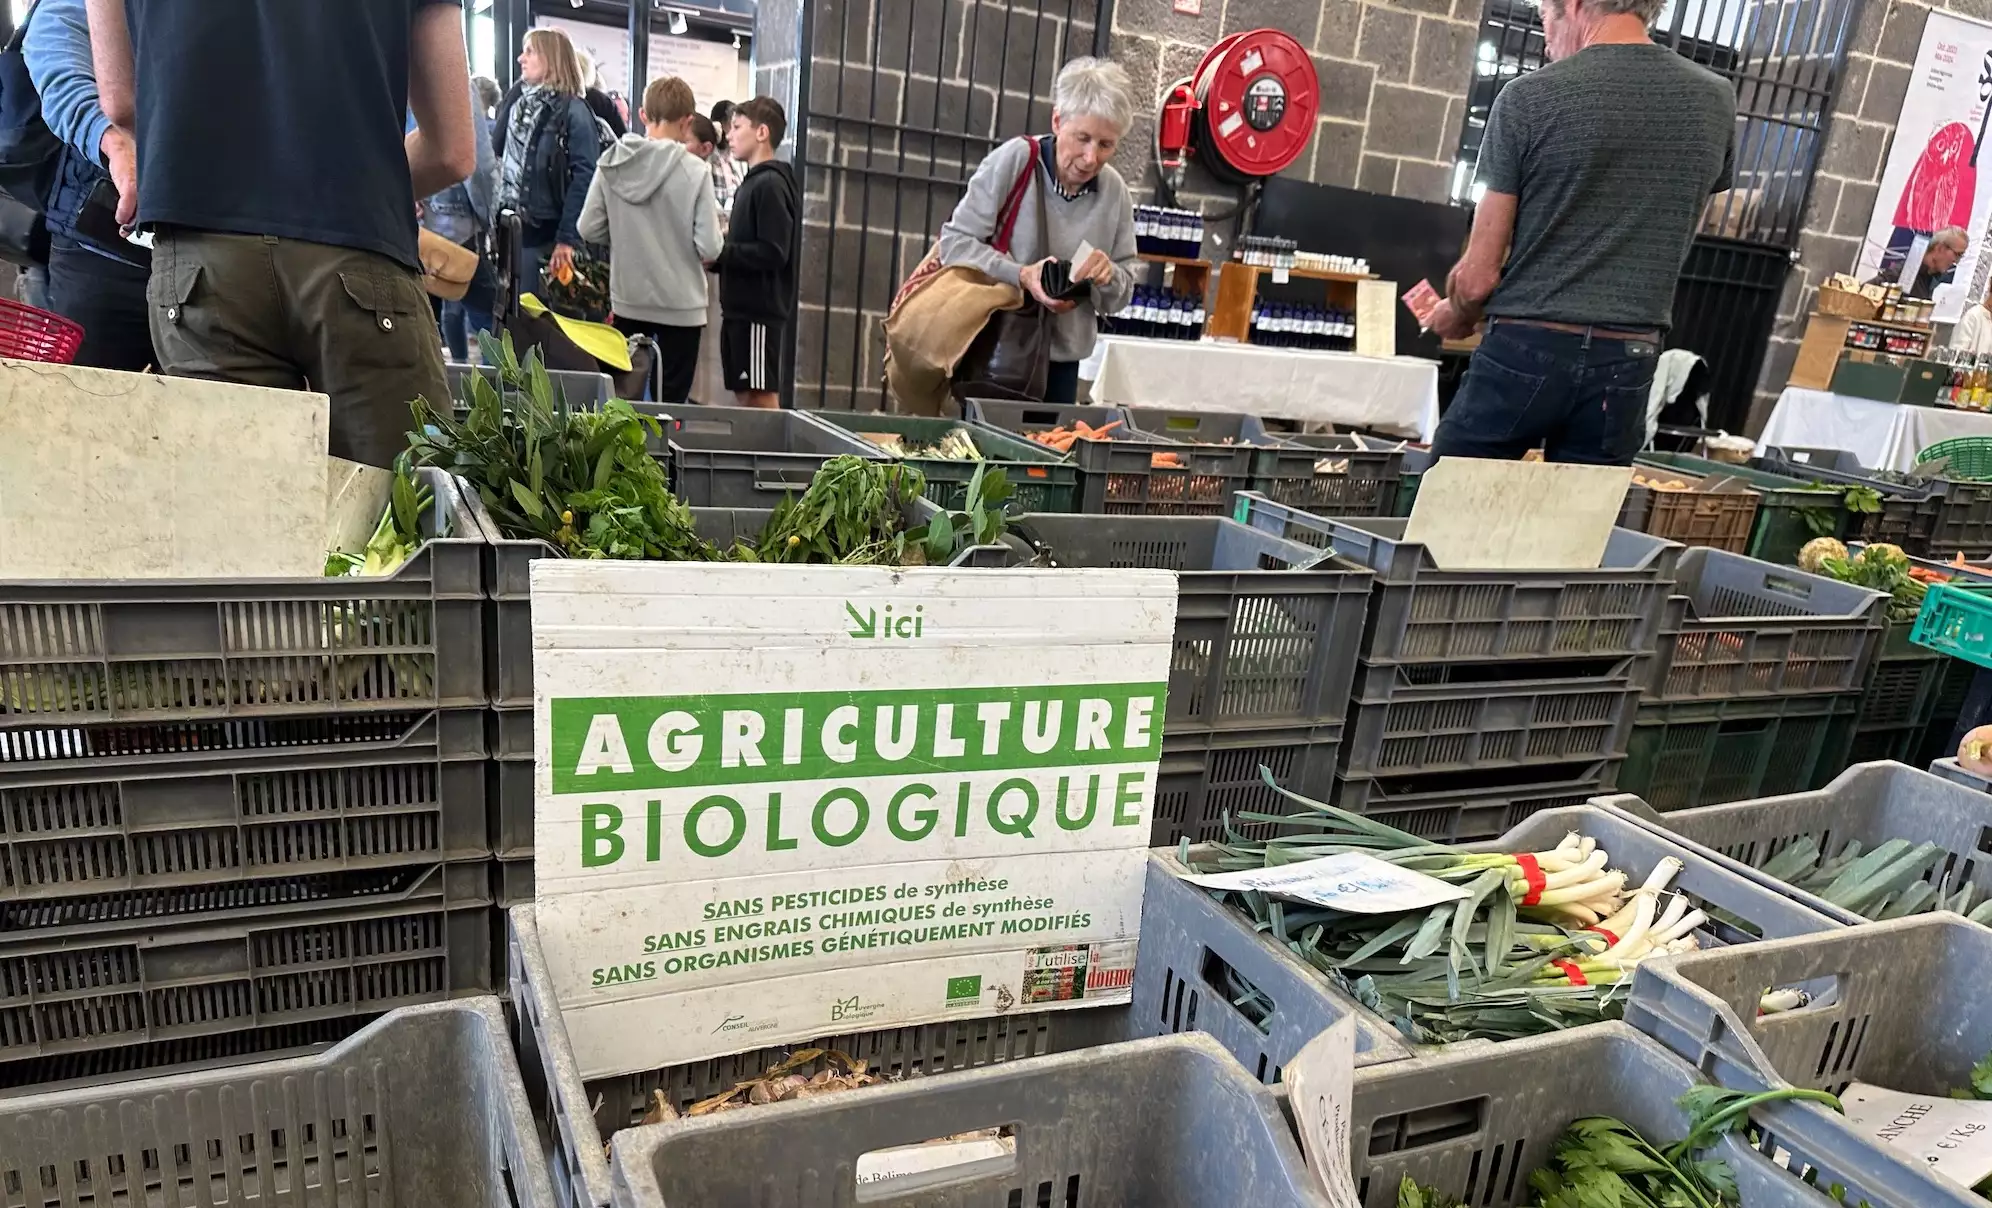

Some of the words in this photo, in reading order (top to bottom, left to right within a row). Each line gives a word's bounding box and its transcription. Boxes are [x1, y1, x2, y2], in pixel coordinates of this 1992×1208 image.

[884, 604, 924, 639] ici
[574, 696, 1155, 776] AGRICULTURE
[581, 771, 1146, 868] BIOLOGIQUE
[642, 928, 707, 954] SANS
[714, 916, 812, 943] ENGRAIS
[819, 904, 936, 931] CHIMIQUES
[942, 902, 966, 918] de
[972, 895, 1055, 918] synthèse
[702, 897, 764, 921] SANS
[771, 885, 888, 912] PESTICIDES
[894, 883, 918, 899] de
[924, 876, 1009, 899] synthèse
[591, 960, 657, 987] SANS
[664, 940, 814, 975] ORGANISMES
[821, 920, 995, 954] GÉNÉTIQUEMENT
[1000, 909, 1092, 936] MODIFIÉS
[722, 1022, 749, 1031] CONSEIL
[1876, 1103, 1933, 1142] ANCHE
